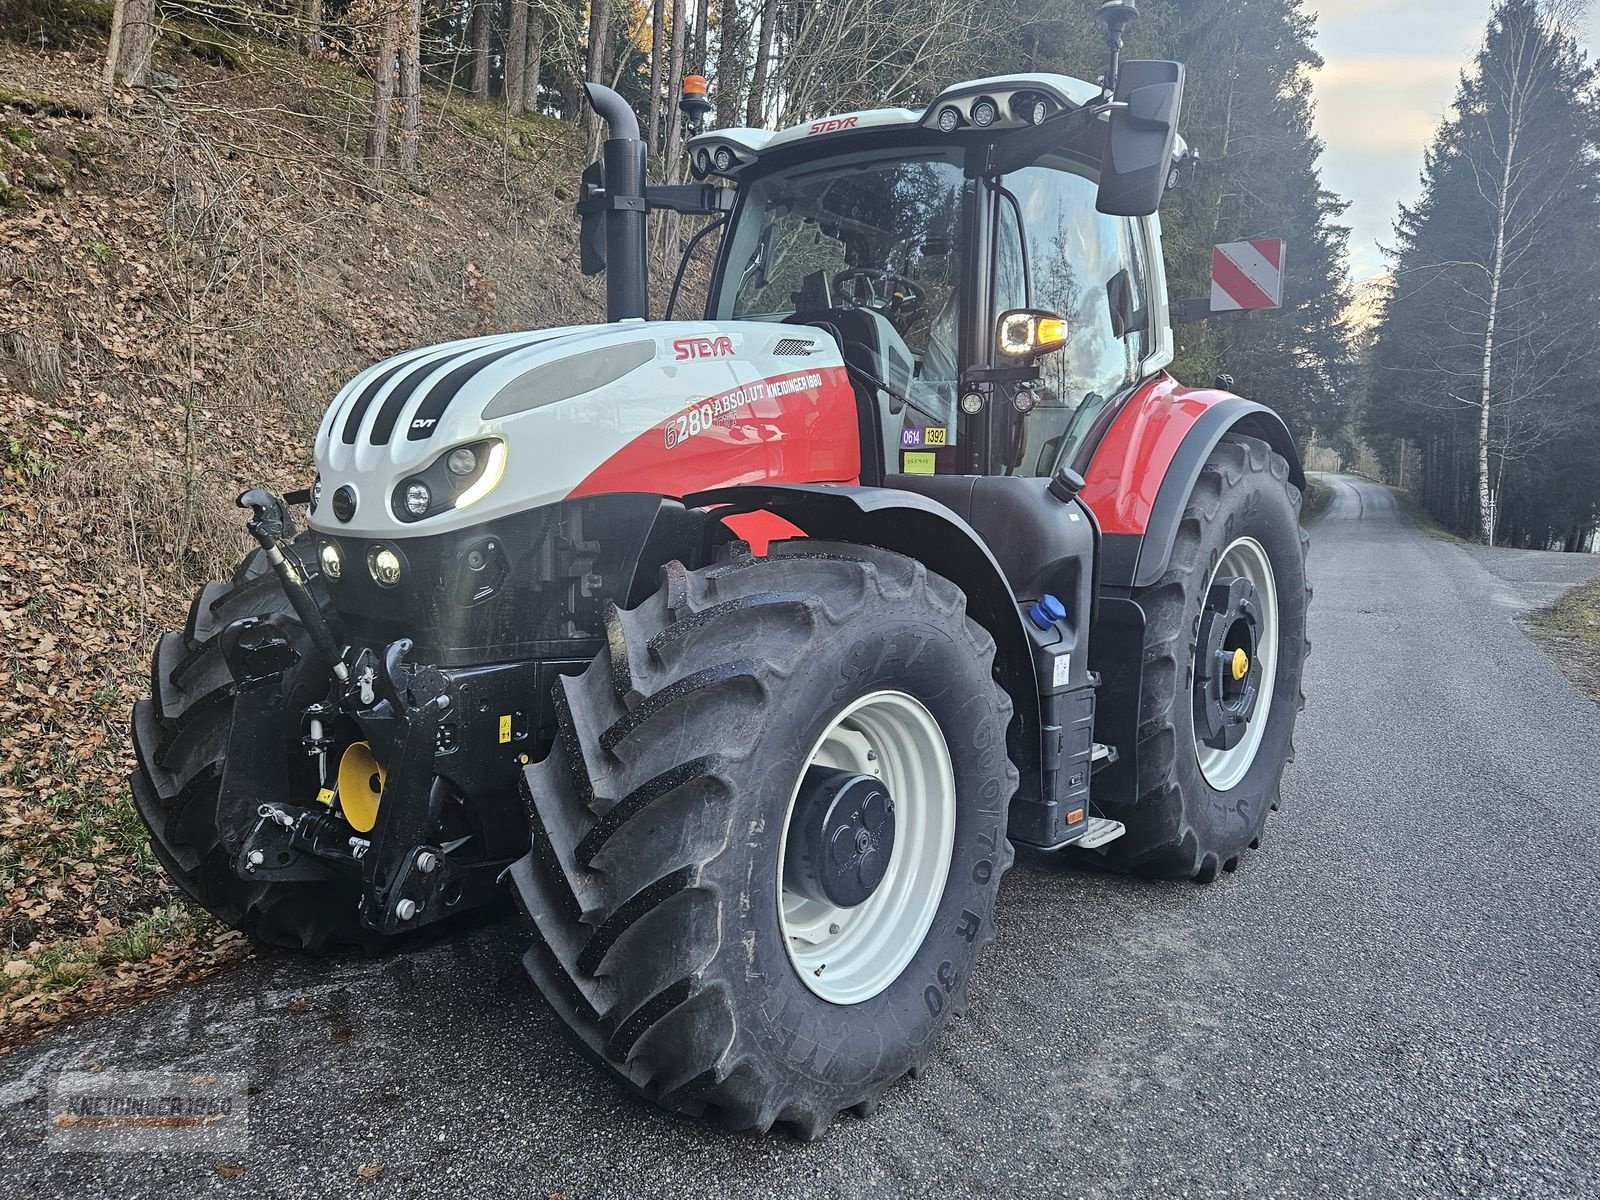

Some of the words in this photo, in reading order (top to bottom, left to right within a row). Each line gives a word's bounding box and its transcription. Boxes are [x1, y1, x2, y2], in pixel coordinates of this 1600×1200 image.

[808, 116, 858, 135] STEYR
[672, 336, 736, 361] STEYR
[411, 418, 437, 428] CVT
[664, 403, 714, 450] 6280
[713, 384, 765, 417] ABSOLUT
[903, 430, 920, 444] 0614
[927, 429, 944, 443] 1392
